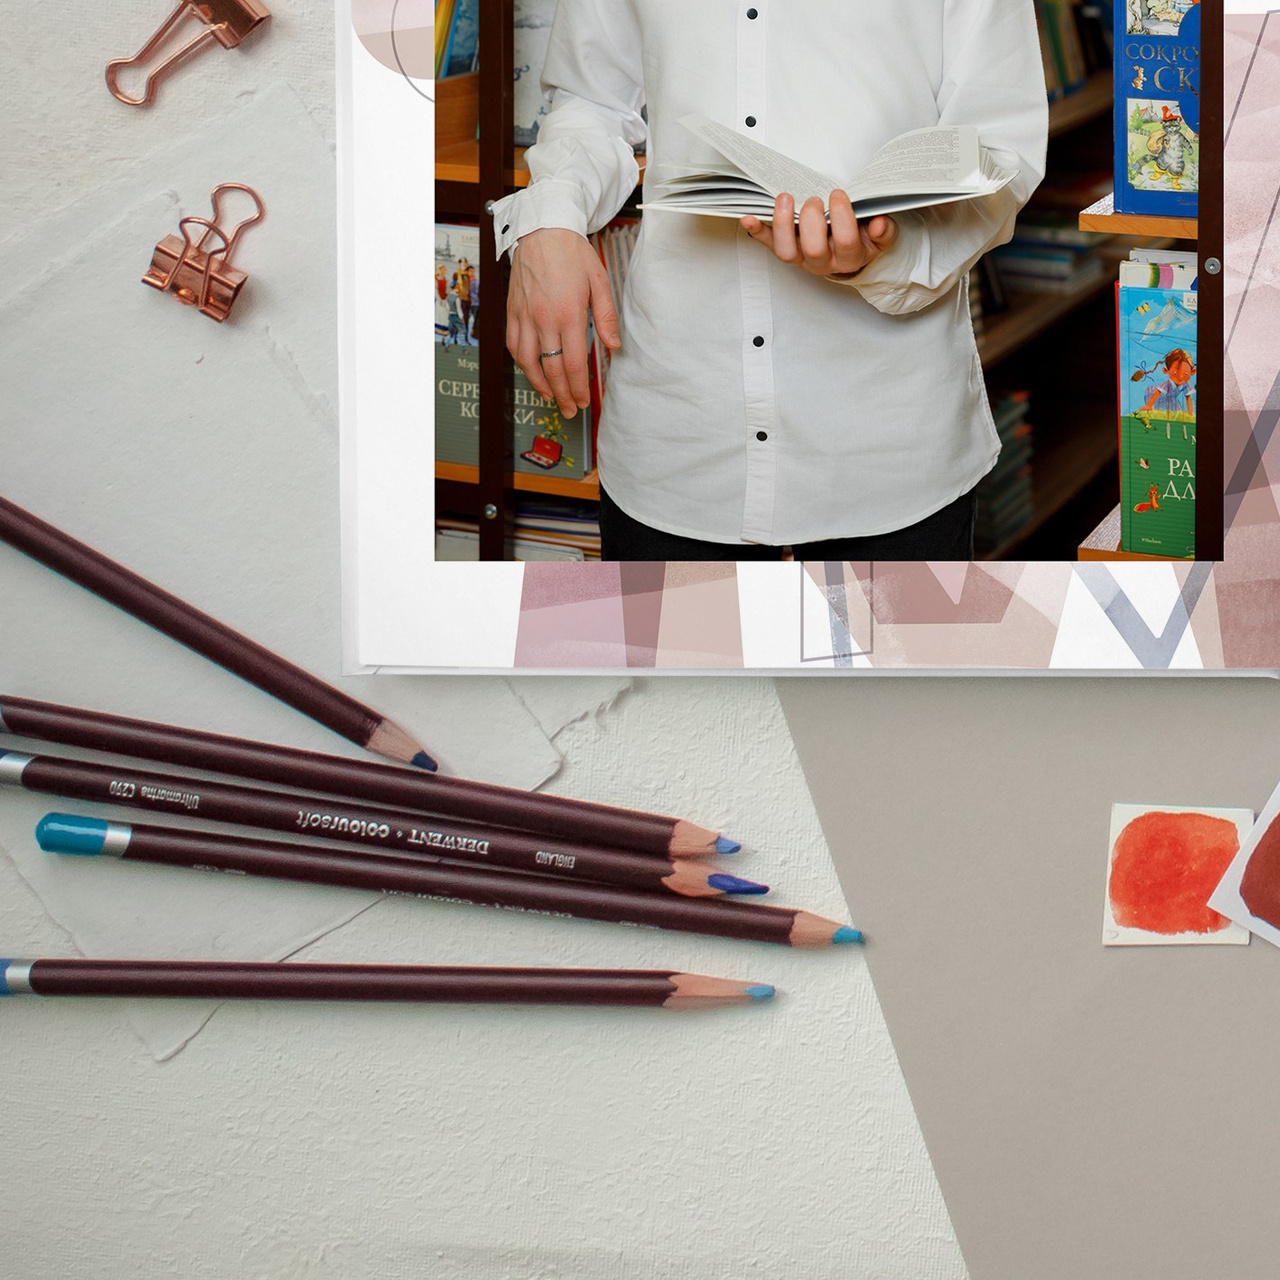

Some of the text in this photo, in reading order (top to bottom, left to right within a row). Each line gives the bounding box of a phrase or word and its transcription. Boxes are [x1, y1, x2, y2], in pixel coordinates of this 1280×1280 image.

[108, 780, 136, 797] C290
[139, 786, 199, 809] Ultramarine
[407, 828, 489, 854] DERWENT
[534, 850, 575, 868] ENGLAND
